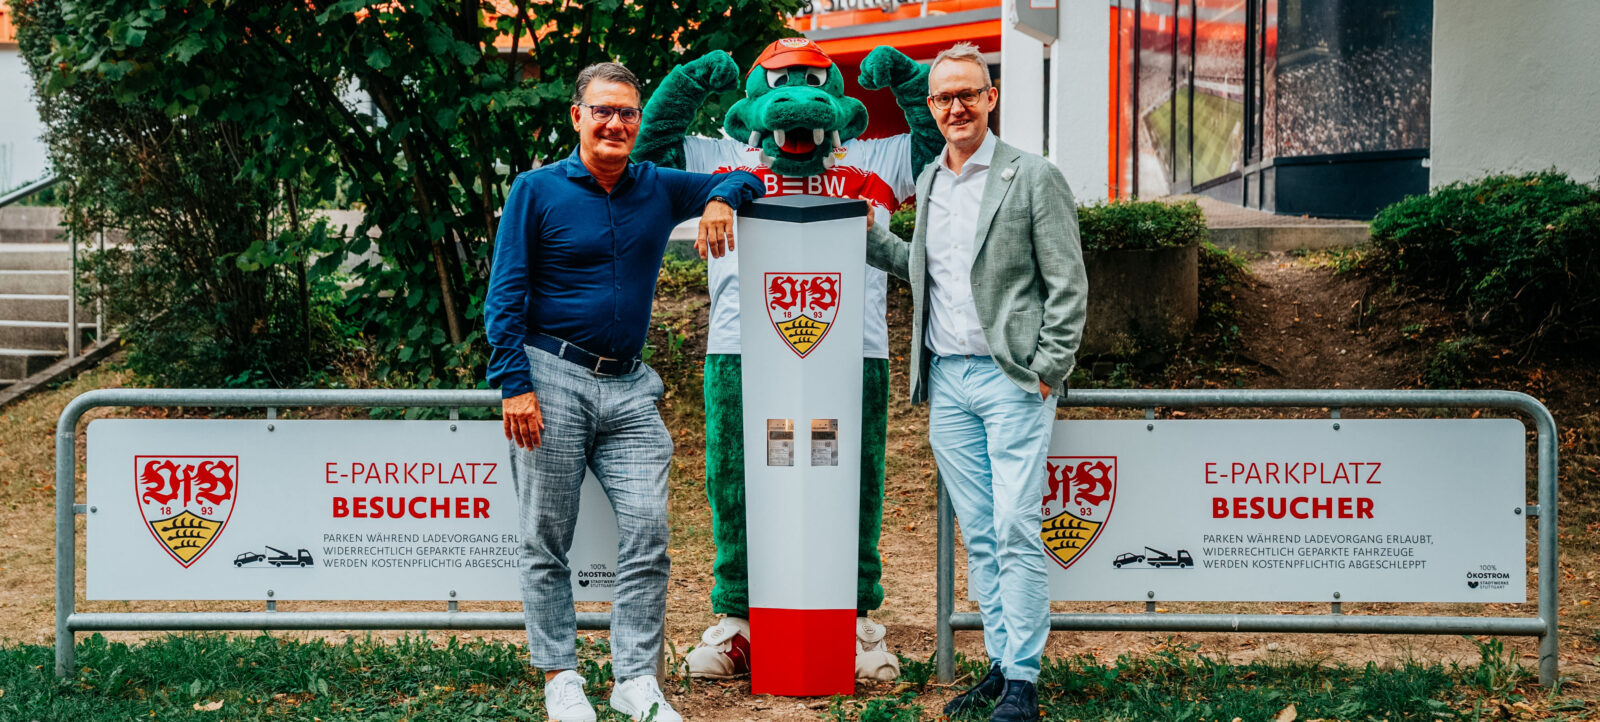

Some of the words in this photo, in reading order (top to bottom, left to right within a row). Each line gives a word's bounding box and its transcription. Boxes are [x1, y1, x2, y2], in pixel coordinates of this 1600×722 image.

[783, 311, 792, 319] 18
[813, 311, 823, 319] 93
[325, 462, 498, 485] E-PARKPLATZ
[1204, 462, 1382, 485] E-PARKPLATZ
[160, 506, 172, 516] 18
[201, 506, 213, 516] 93
[332, 496, 491, 519] BESUCHER
[1080, 507, 1092, 516] 93
[1211, 496, 1375, 520] BESUCHER
[323, 533, 363, 543] PARKEN
[366, 531, 420, 543] WÄHREND
[422, 533, 499, 543] LADEVORGANG
[501, 533, 520, 543] ERL
[1203, 534, 1243, 544] PARKEN
[1246, 532, 1301, 544] WÄHREND
[1304, 534, 1383, 544] LADEVORGANG
[1386, 534, 1434, 545] ERLAUBT,
[323, 546, 413, 556] WIDERRECHTLICH
[415, 546, 466, 556] GEPARKTE
[1202, 547, 1294, 557] WIDERRECHTLICH
[1297, 547, 1349, 557] GEPARKTE
[1353, 547, 1415, 557] FAHRZEUGE
[323, 558, 368, 568] WERDEN
[371, 558, 462, 568] KOSTENPFLICHTIG
[1202, 559, 1248, 569] WERDEN
[1252, 559, 1345, 569] KOSTENPFLICHTIG
[1348, 559, 1427, 569] ABGESCHLEPPT
[1466, 571, 1510, 579] ÖKOSTROM
